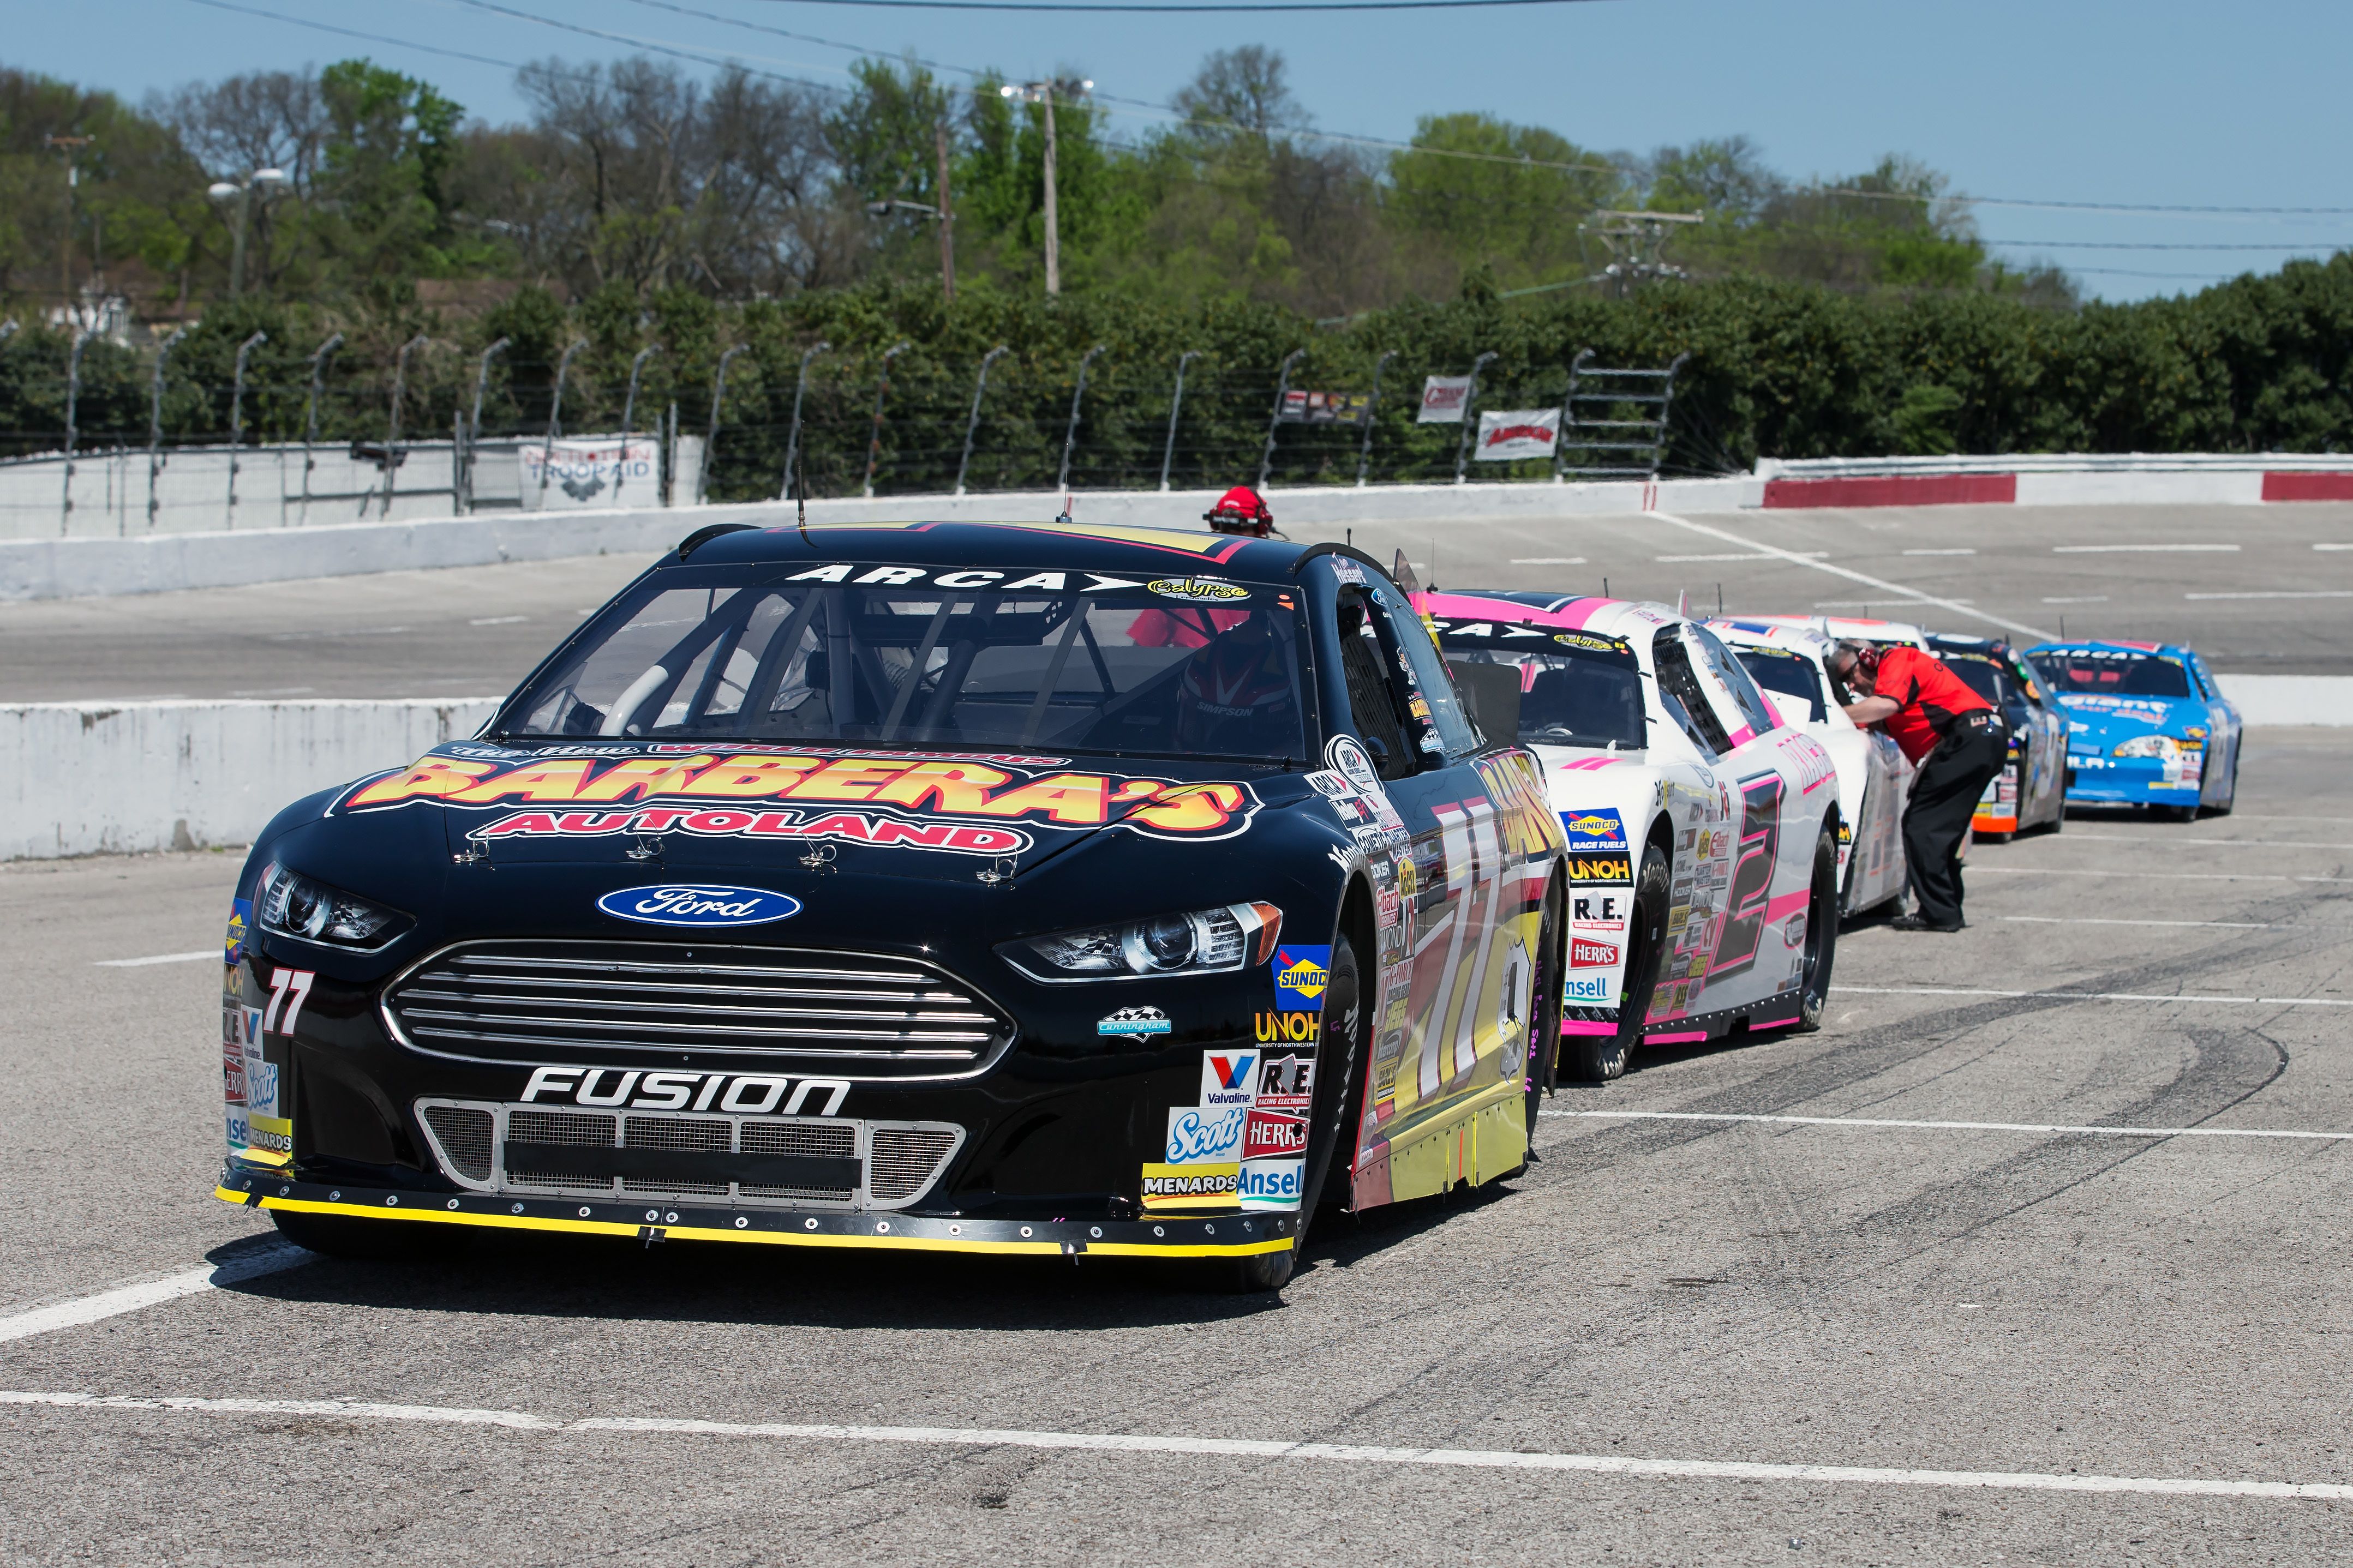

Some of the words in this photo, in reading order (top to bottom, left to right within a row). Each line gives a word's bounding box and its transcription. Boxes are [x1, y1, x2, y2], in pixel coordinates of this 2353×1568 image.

[785, 564, 1066, 590] ARCA
[1147, 578, 1249, 598] Calypso
[1196, 701, 1254, 717] SIMPSON
[1340, 748, 1360, 768] ARCA
[346, 754, 1246, 831] BARBERA'S
[1311, 773, 1346, 797] ARCA
[489, 808, 1016, 851] AUTOLAND
[1571, 821, 1616, 830] SUNOCO
[1598, 841, 1626, 849] FUELS
[1568, 860, 1630, 879] UNOH
[634, 887, 757, 919] Ford
[1418, 796, 1501, 1100] 77
[1574, 944, 1615, 964] HERR'S
[1565, 977, 1607, 996] nsell
[264, 966, 316, 1036] 77
[1099, 1022, 1170, 1031] Cunningham
[247, 1062, 277, 1112] Scott
[520, 1066, 851, 1116] FUSION
[1207, 1093, 1250, 1104] Valvoline
[249, 1126, 292, 1152] MENARDS
[1165, 1108, 1244, 1164] Scott
[1142, 1175, 1237, 1195] MENARDS
